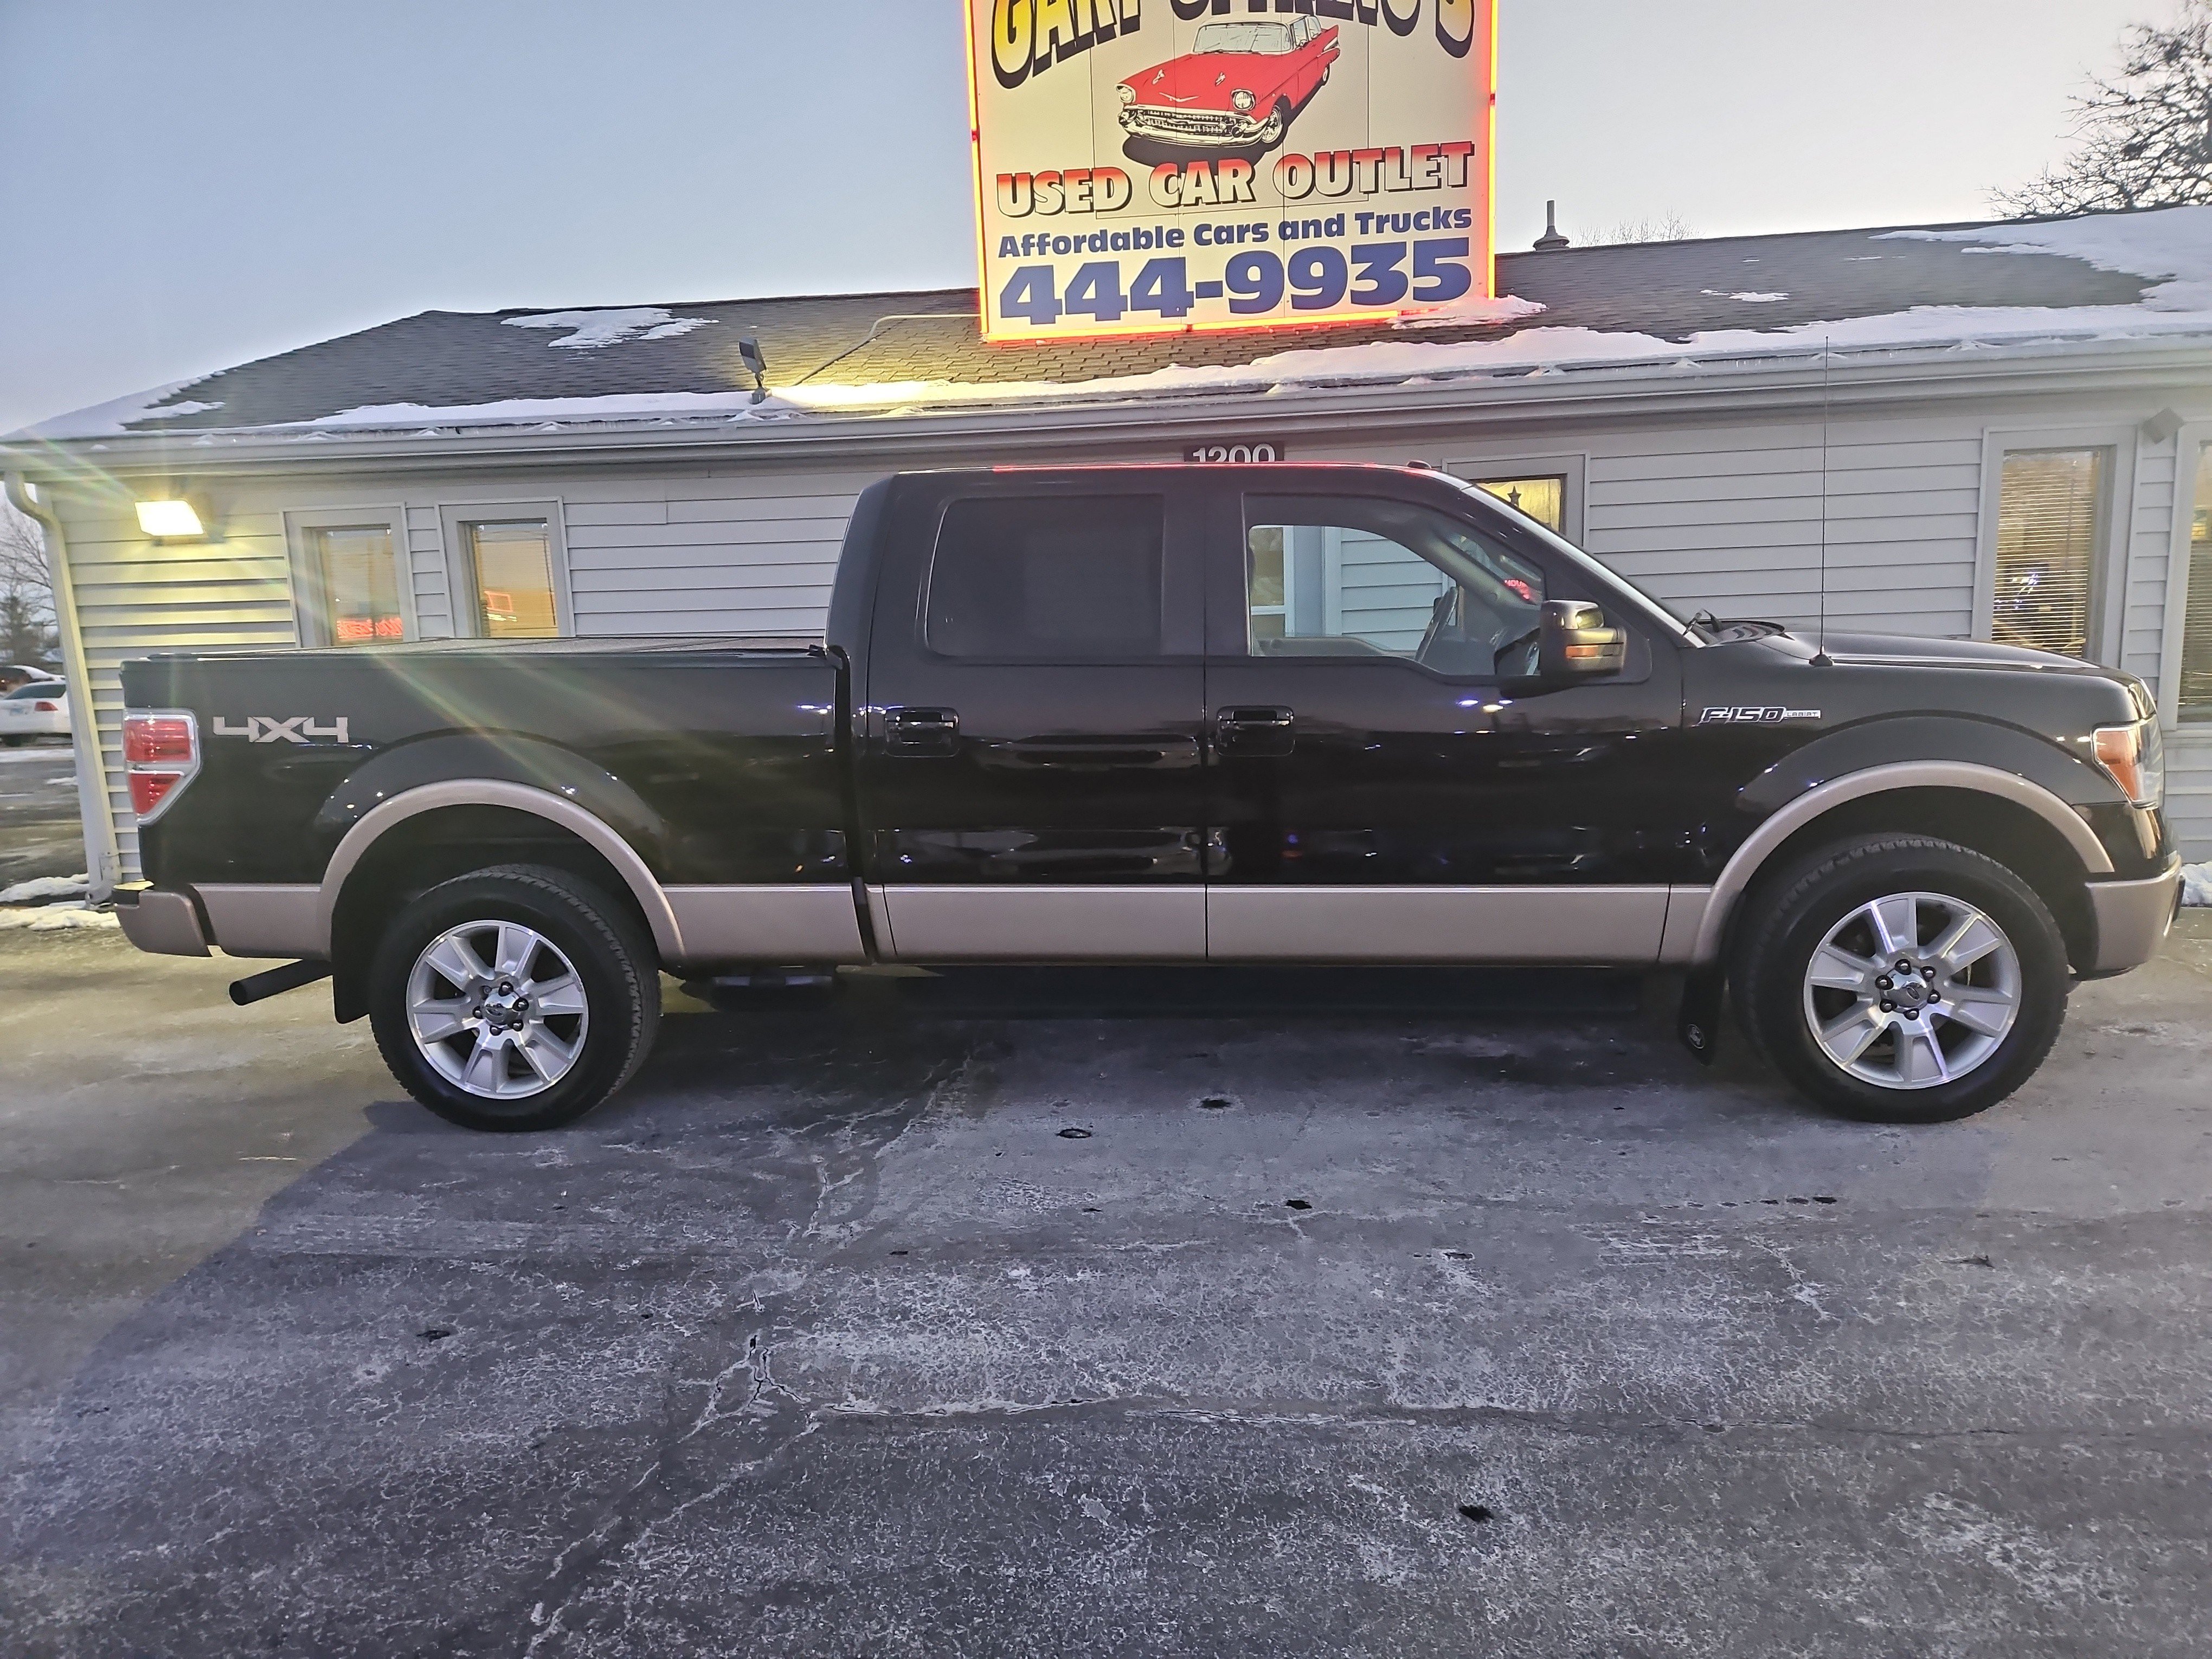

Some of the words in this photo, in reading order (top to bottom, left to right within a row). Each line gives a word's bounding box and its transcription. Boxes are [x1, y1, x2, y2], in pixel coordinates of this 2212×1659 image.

[996, 166, 1133, 217] USED
[1148, 159, 1256, 208] CAR
[1272, 141, 1475, 200] OUTLET
[998, 226, 1185, 258] Affordable
[1194, 222, 1269, 247] Cars
[1278, 213, 1345, 240] and
[1355, 206, 1472, 235] Trucks
[1000, 237, 1472, 325] 444-9935
[1193, 443, 1275, 463] 1200
[1701, 706, 1787, 723] F-150
